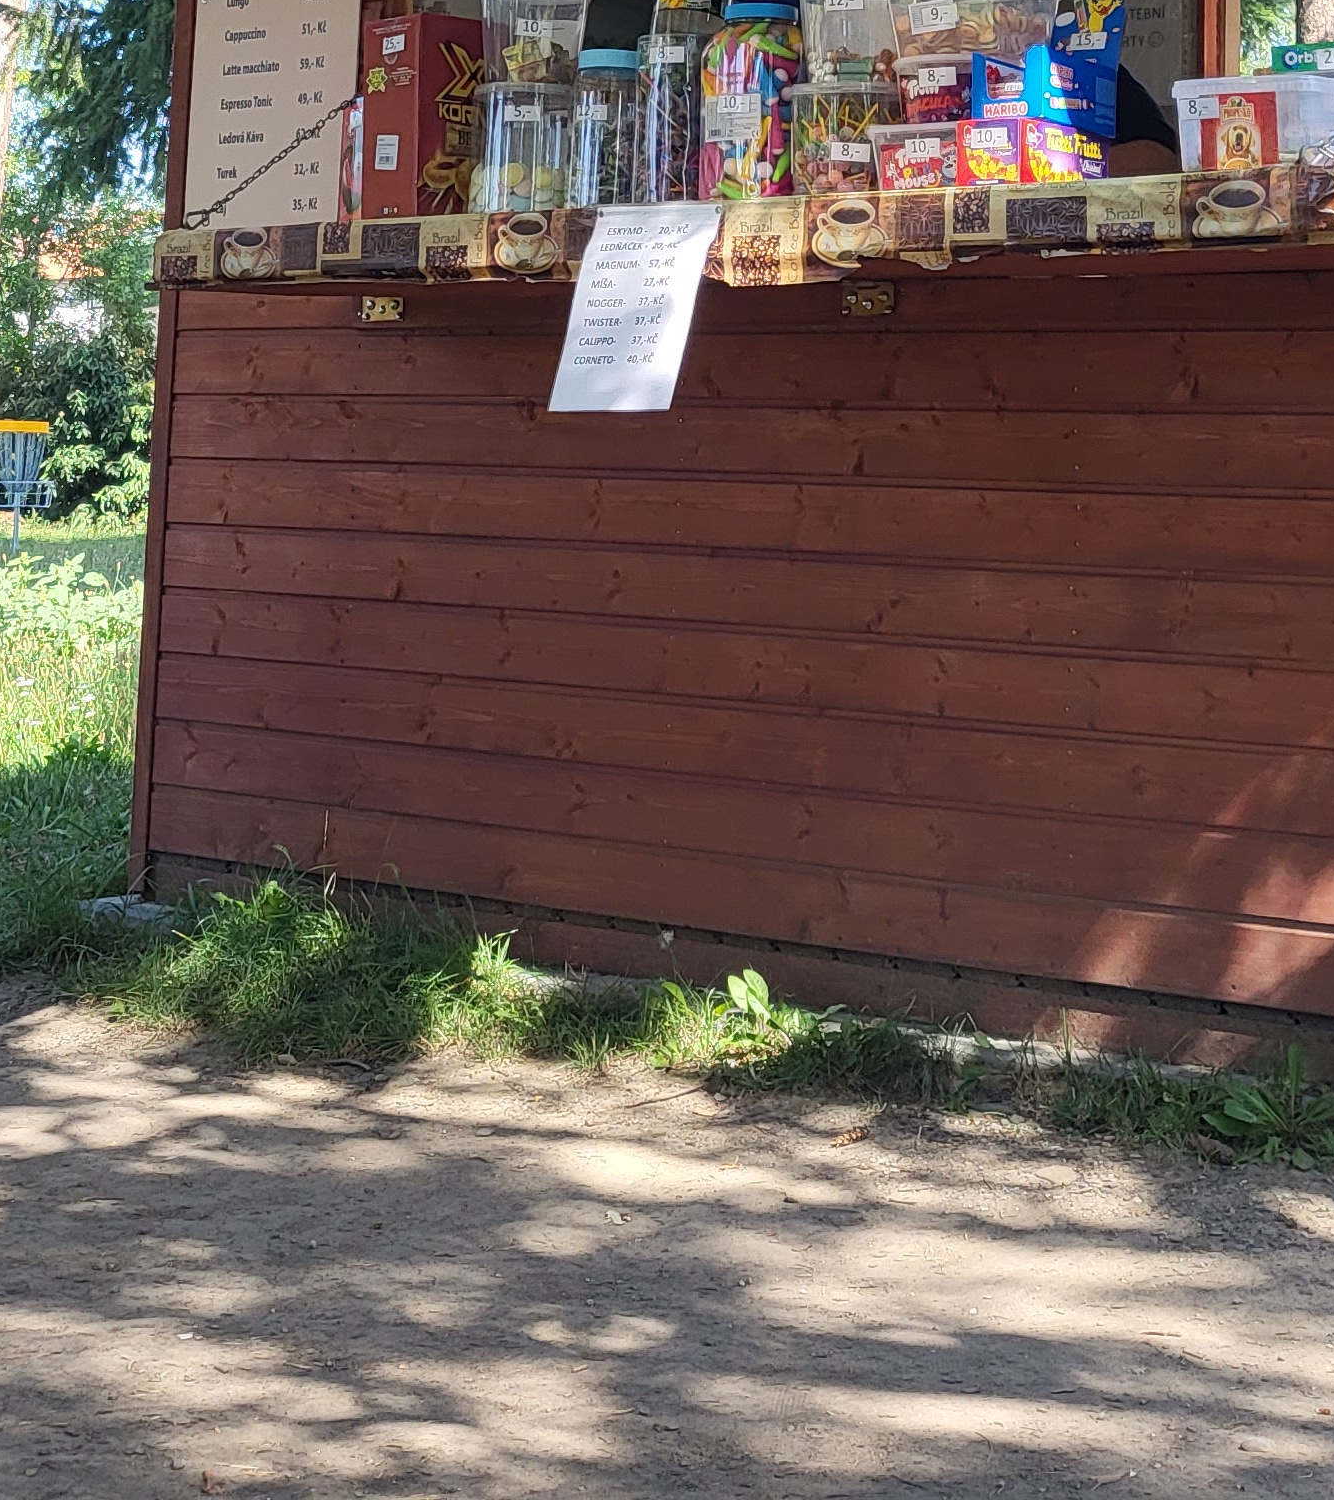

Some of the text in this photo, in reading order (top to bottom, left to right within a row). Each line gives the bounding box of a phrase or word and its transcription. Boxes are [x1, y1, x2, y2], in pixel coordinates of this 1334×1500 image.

[930, 7, 949, 24] 9,-
[1128, 4, 1167, 20] TEBNÍ
[224, 21, 327, 43] Cappuccino 51,- Kč
[521, 20, 548, 36] 10,-
[385, 38, 400, 50] 25,-
[1076, 33, 1101, 48] 15,-
[1121, 36, 1146, 48] RTY
[657, 47, 676, 60] 8,-
[222, 56, 325, 76] Latte macchiato 59,- Kč
[927, 69, 946, 84] 8,-
[220, 99, 252, 113] Espresso
[253, 94, 273, 108] Tonic
[313, 91, 323, 104] Kč
[722, 97, 745, 110] 10,-
[984, 101, 1028, 118] HARIBO
[1188, 99, 1208, 116] 8,-
[513, 105, 533, 118] 5,-
[578, 105, 600, 118] 12,-
[218, 131, 245, 145] Ledová
[246, 130, 264, 143] Káva
[977, 130, 1002, 145] 10,-
[1045, 127, 1074, 154] Tutti
[1074, 133, 1102, 159] Frutti
[840, 143, 861, 158] 8,-
[910, 140, 936, 155] 10,-
[217, 161, 319, 180] Turek 32,- Kč
[292, 199, 307, 211] 35,-
[308, 197, 318, 210] Kč
[1105, 201, 1145, 221] Brazil
[607, 226, 643, 236] ESKYMO
[739, 217, 773, 234] Brazil
[432, 228, 461, 244] Brazil
